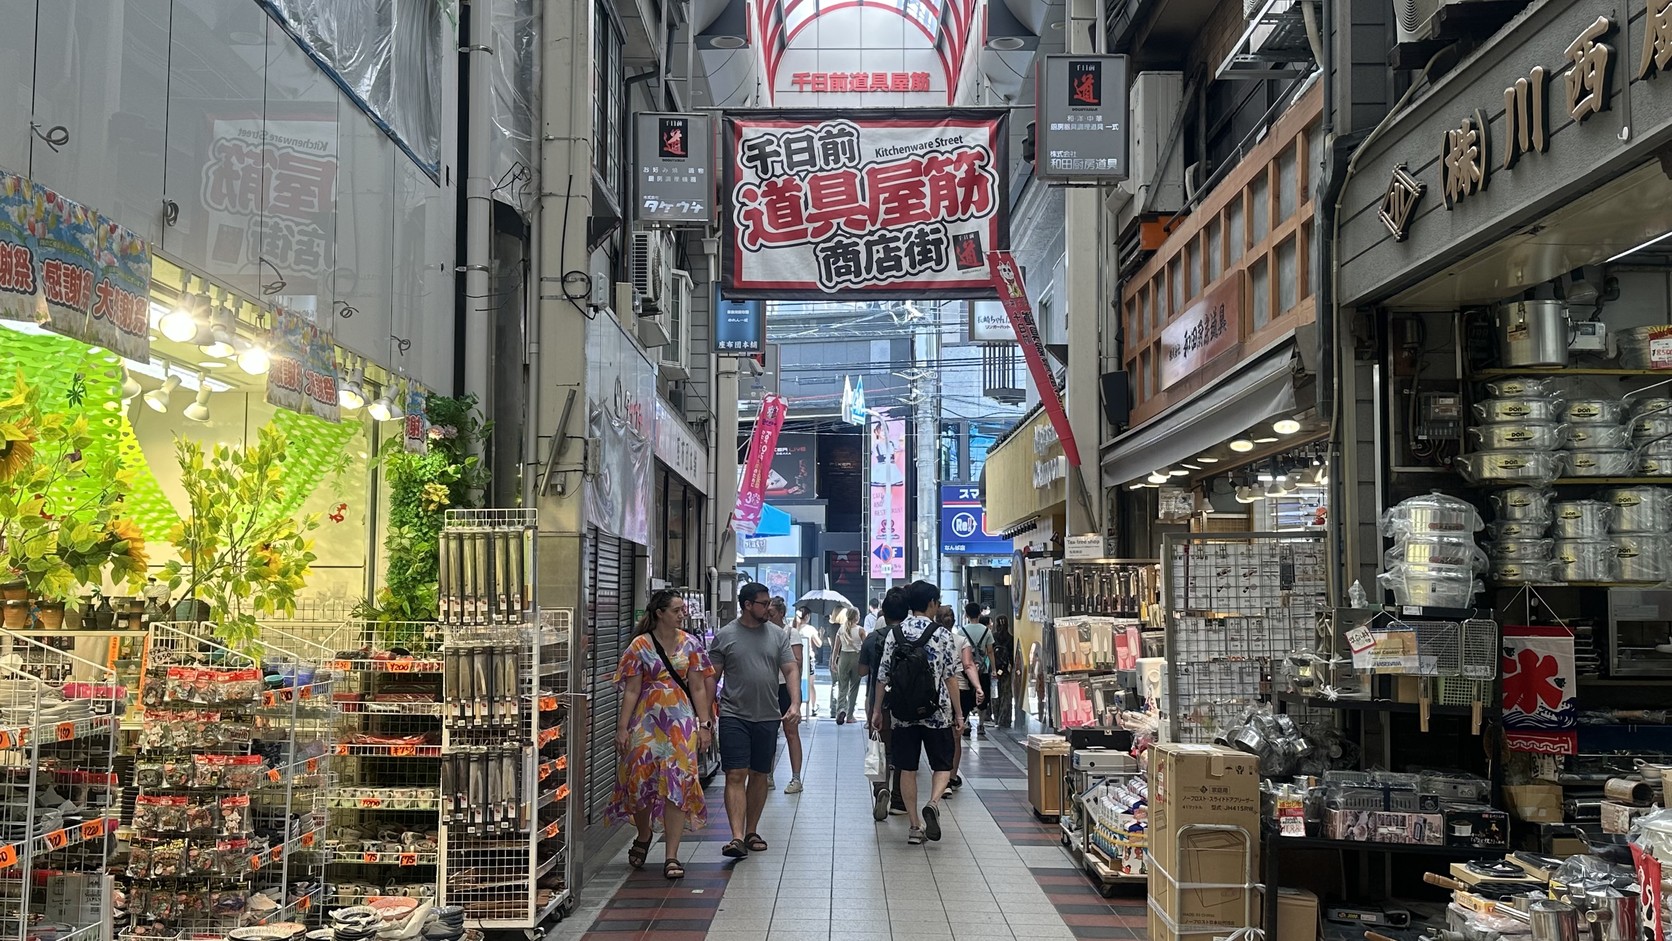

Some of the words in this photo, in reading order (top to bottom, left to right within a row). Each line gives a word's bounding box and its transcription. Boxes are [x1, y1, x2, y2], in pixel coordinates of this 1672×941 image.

[791, 72, 931, 93] 千日前道具屋筋
[745, 128, 859, 176] 千日前
[875, 140, 934, 159] Kitchenware
[935, 135, 964, 149] Street
[1050, 158, 1118, 170] 和田厨房道具
[741, 150, 991, 247] 道具屋筋
[821, 226, 946, 284] 商店街
